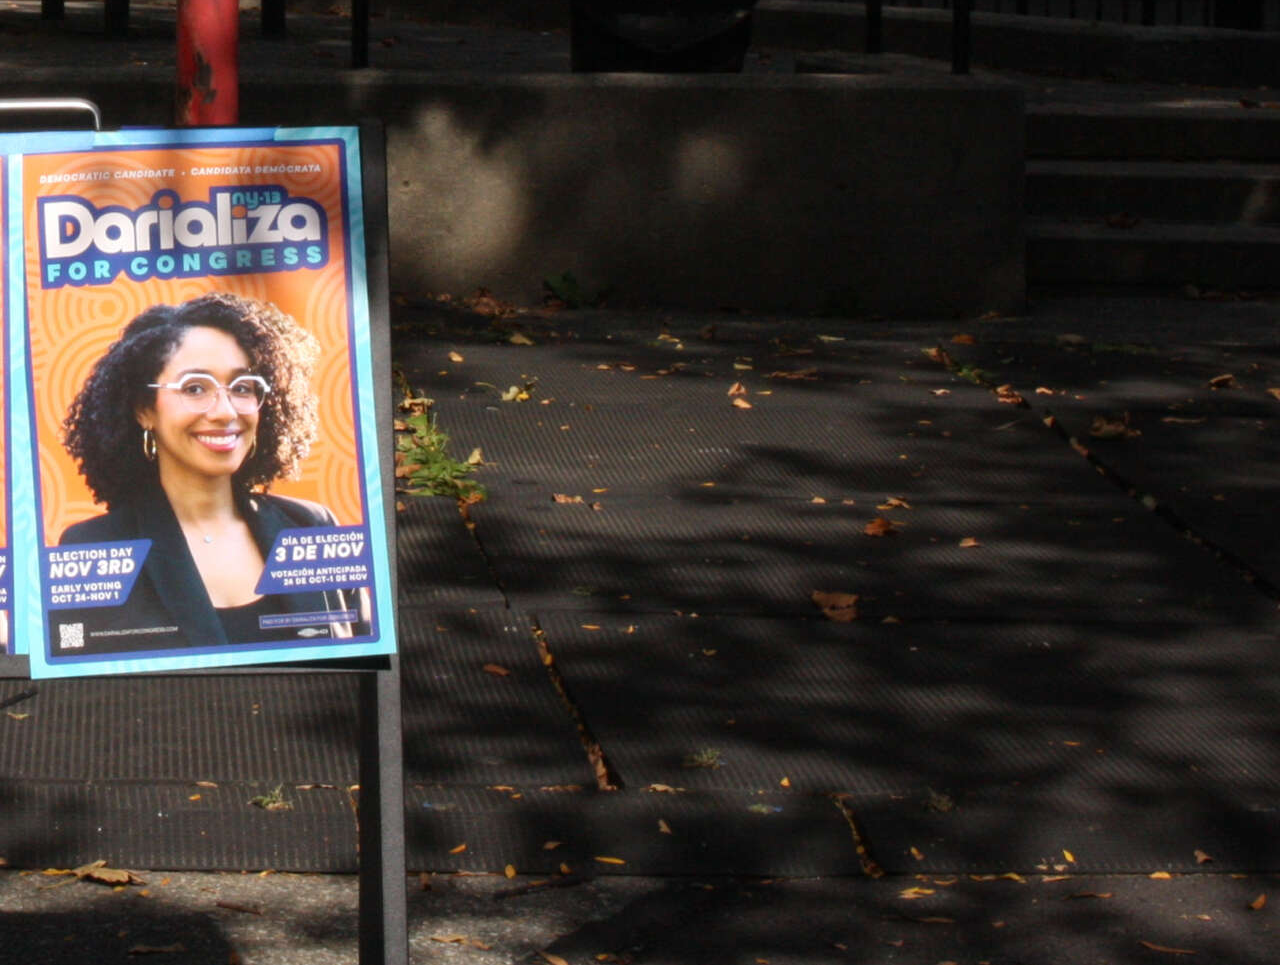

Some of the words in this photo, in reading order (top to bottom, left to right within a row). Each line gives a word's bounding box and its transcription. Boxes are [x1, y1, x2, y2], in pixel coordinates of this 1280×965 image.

[40, 172, 110, 184] DEMOCRATIC
[114, 169, 175, 179] CANDIDATE
[191, 167, 251, 176] CANDIDATA
[232, 190, 281, 209] ny-13
[43, 193, 320, 258] Darializa
[48, 260, 110, 282] FOR
[131, 246, 322, 275] CONGRESS
[282, 534, 298, 545] DÍA
[300, 536, 313, 544] DE
[316, 532, 363, 543] ELECCIÓN
[49, 550, 107, 562] ELECTION
[111, 548, 133, 558] DAY
[275, 548, 286, 562] 3
[292, 545, 318, 561] DE
[323, 543, 364, 558] NOV
[50, 562, 94, 578] NOV
[97, 559, 134, 574] 3RD
[271, 568, 315, 578] VOTACIÓN
[316, 565, 366, 576] ANTICIPADA
[296, 577, 307, 585] DE
[351, 574, 367, 582] NOV
[51, 584, 81, 593] EARLY
[84, 582, 121, 591] VOTING
[52, 594, 72, 603] OCT
